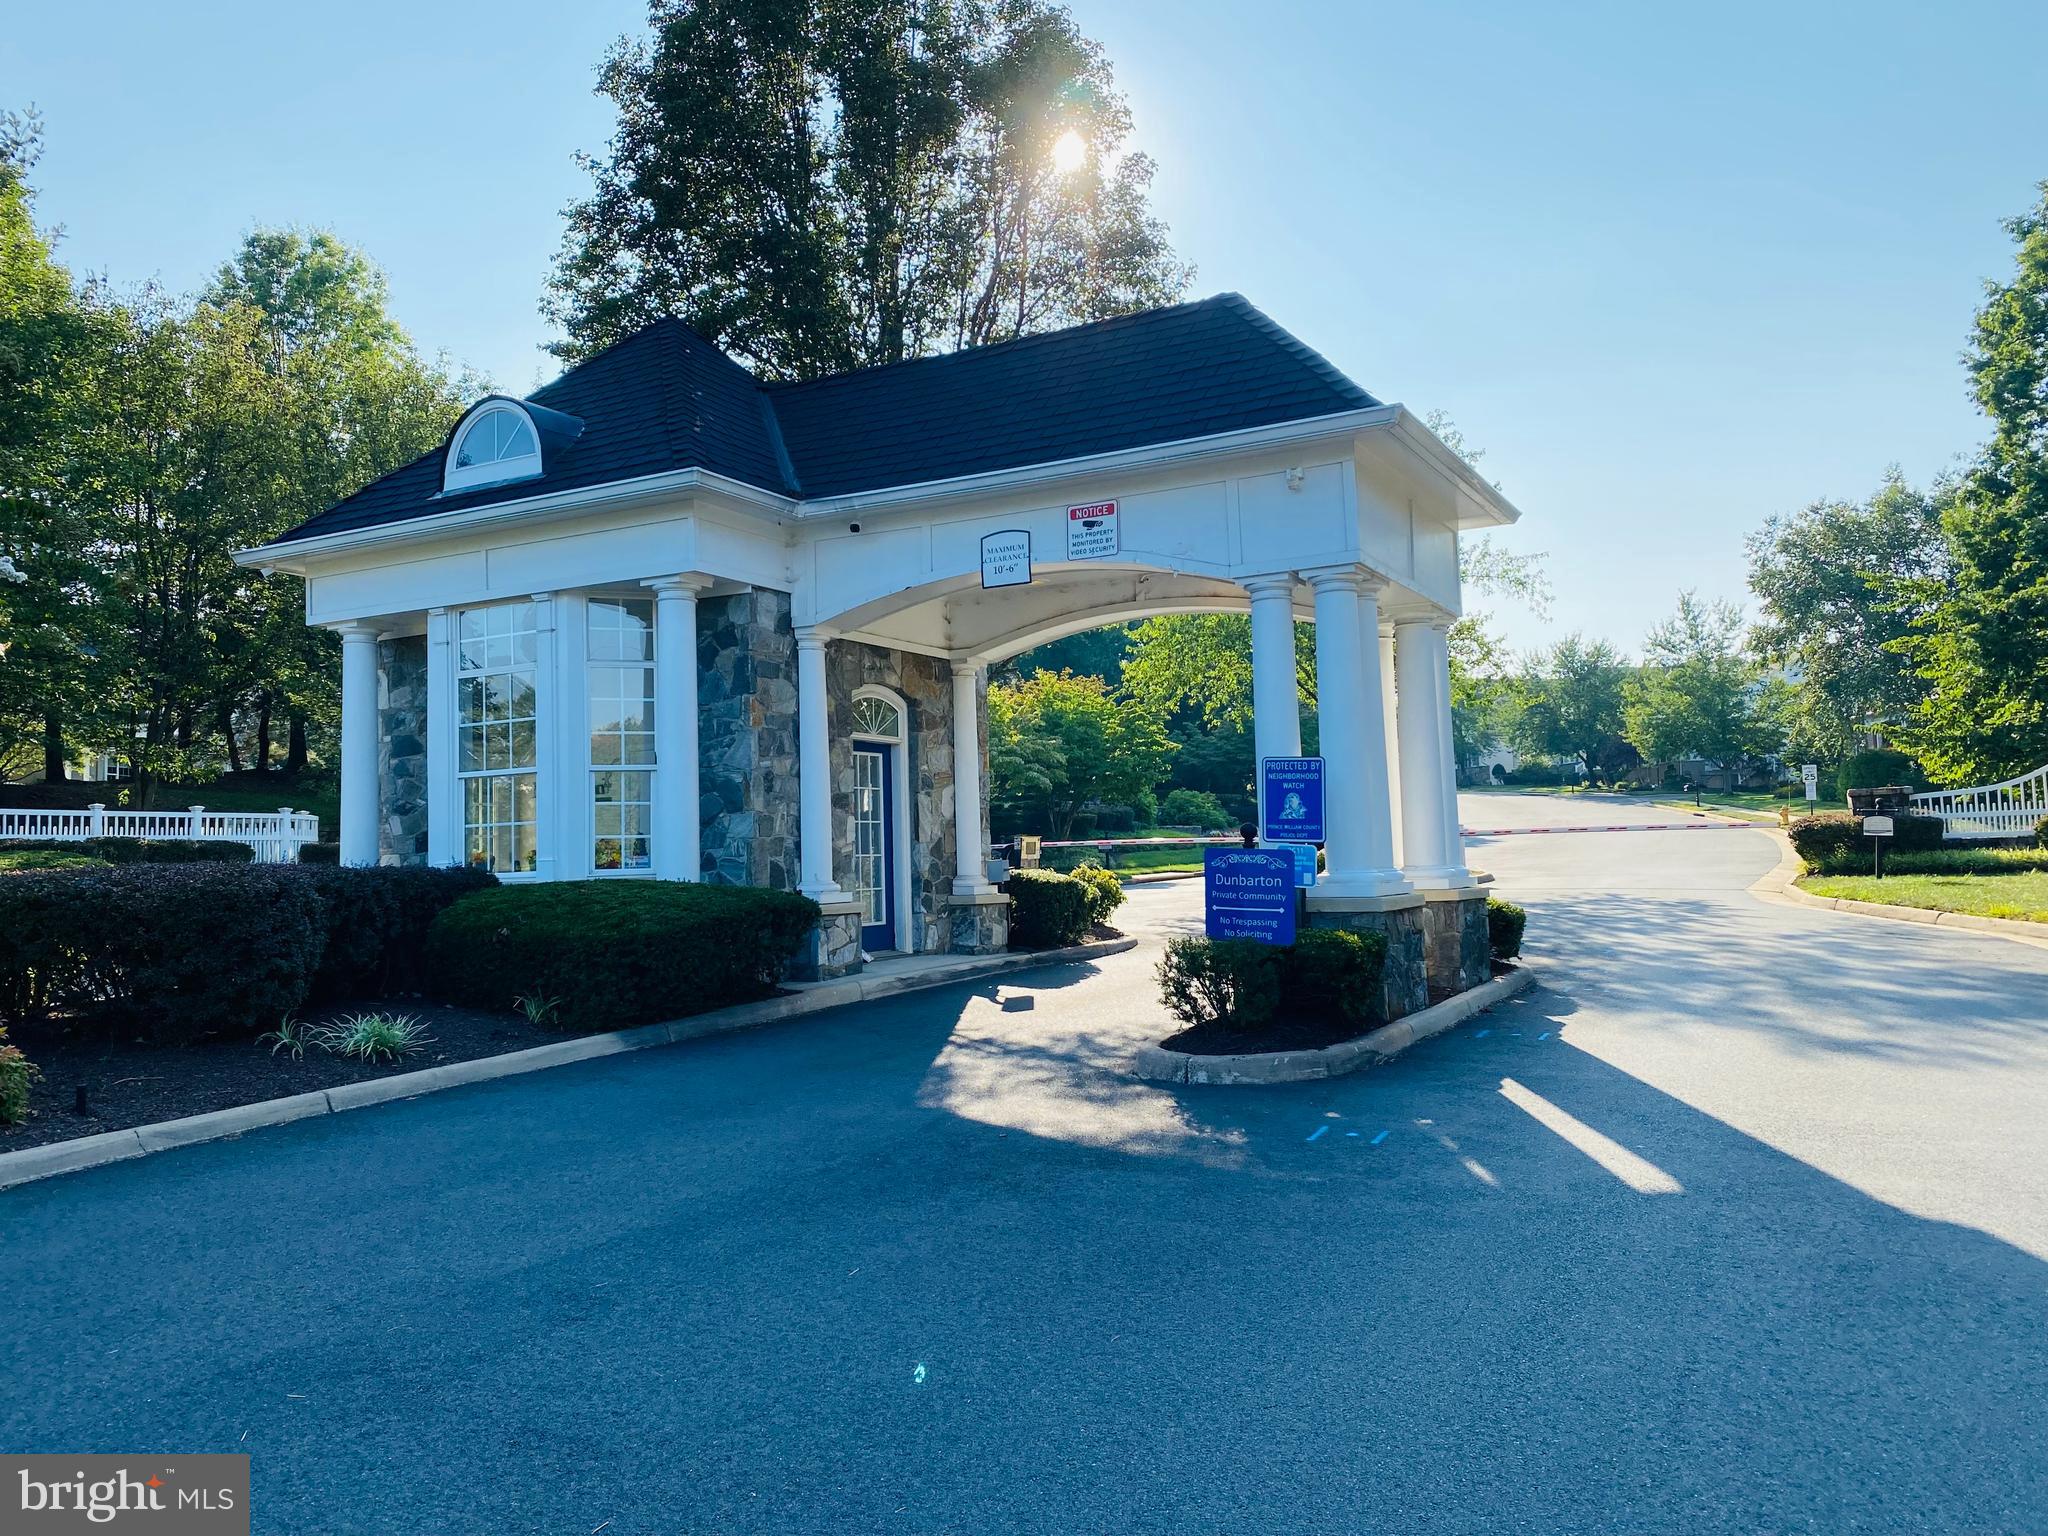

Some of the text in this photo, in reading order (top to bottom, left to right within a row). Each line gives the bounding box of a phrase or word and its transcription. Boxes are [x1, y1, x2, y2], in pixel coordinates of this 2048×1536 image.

[1075, 505, 1109, 518] NOTICE
[1071, 529, 1114, 540] THIS PROPERTY
[1072, 538, 1104, 547] MONITORED
[987, 544, 1025, 554] MAXIMUM
[1071, 544, 1115, 556] VIDEO SECURITY
[985, 552, 1027, 564] CLEARANCE
[1266, 761, 1321, 770] PROTECTED BY
[1268, 772, 1319, 780] NEIGHBORHOOD
[1215, 873, 1282, 887] Dunbarton
[1212, 890, 1287, 902] Private Community
[1220, 916, 1278, 928] No Trespassing
[1224, 929, 1273, 940] No Soliciting
